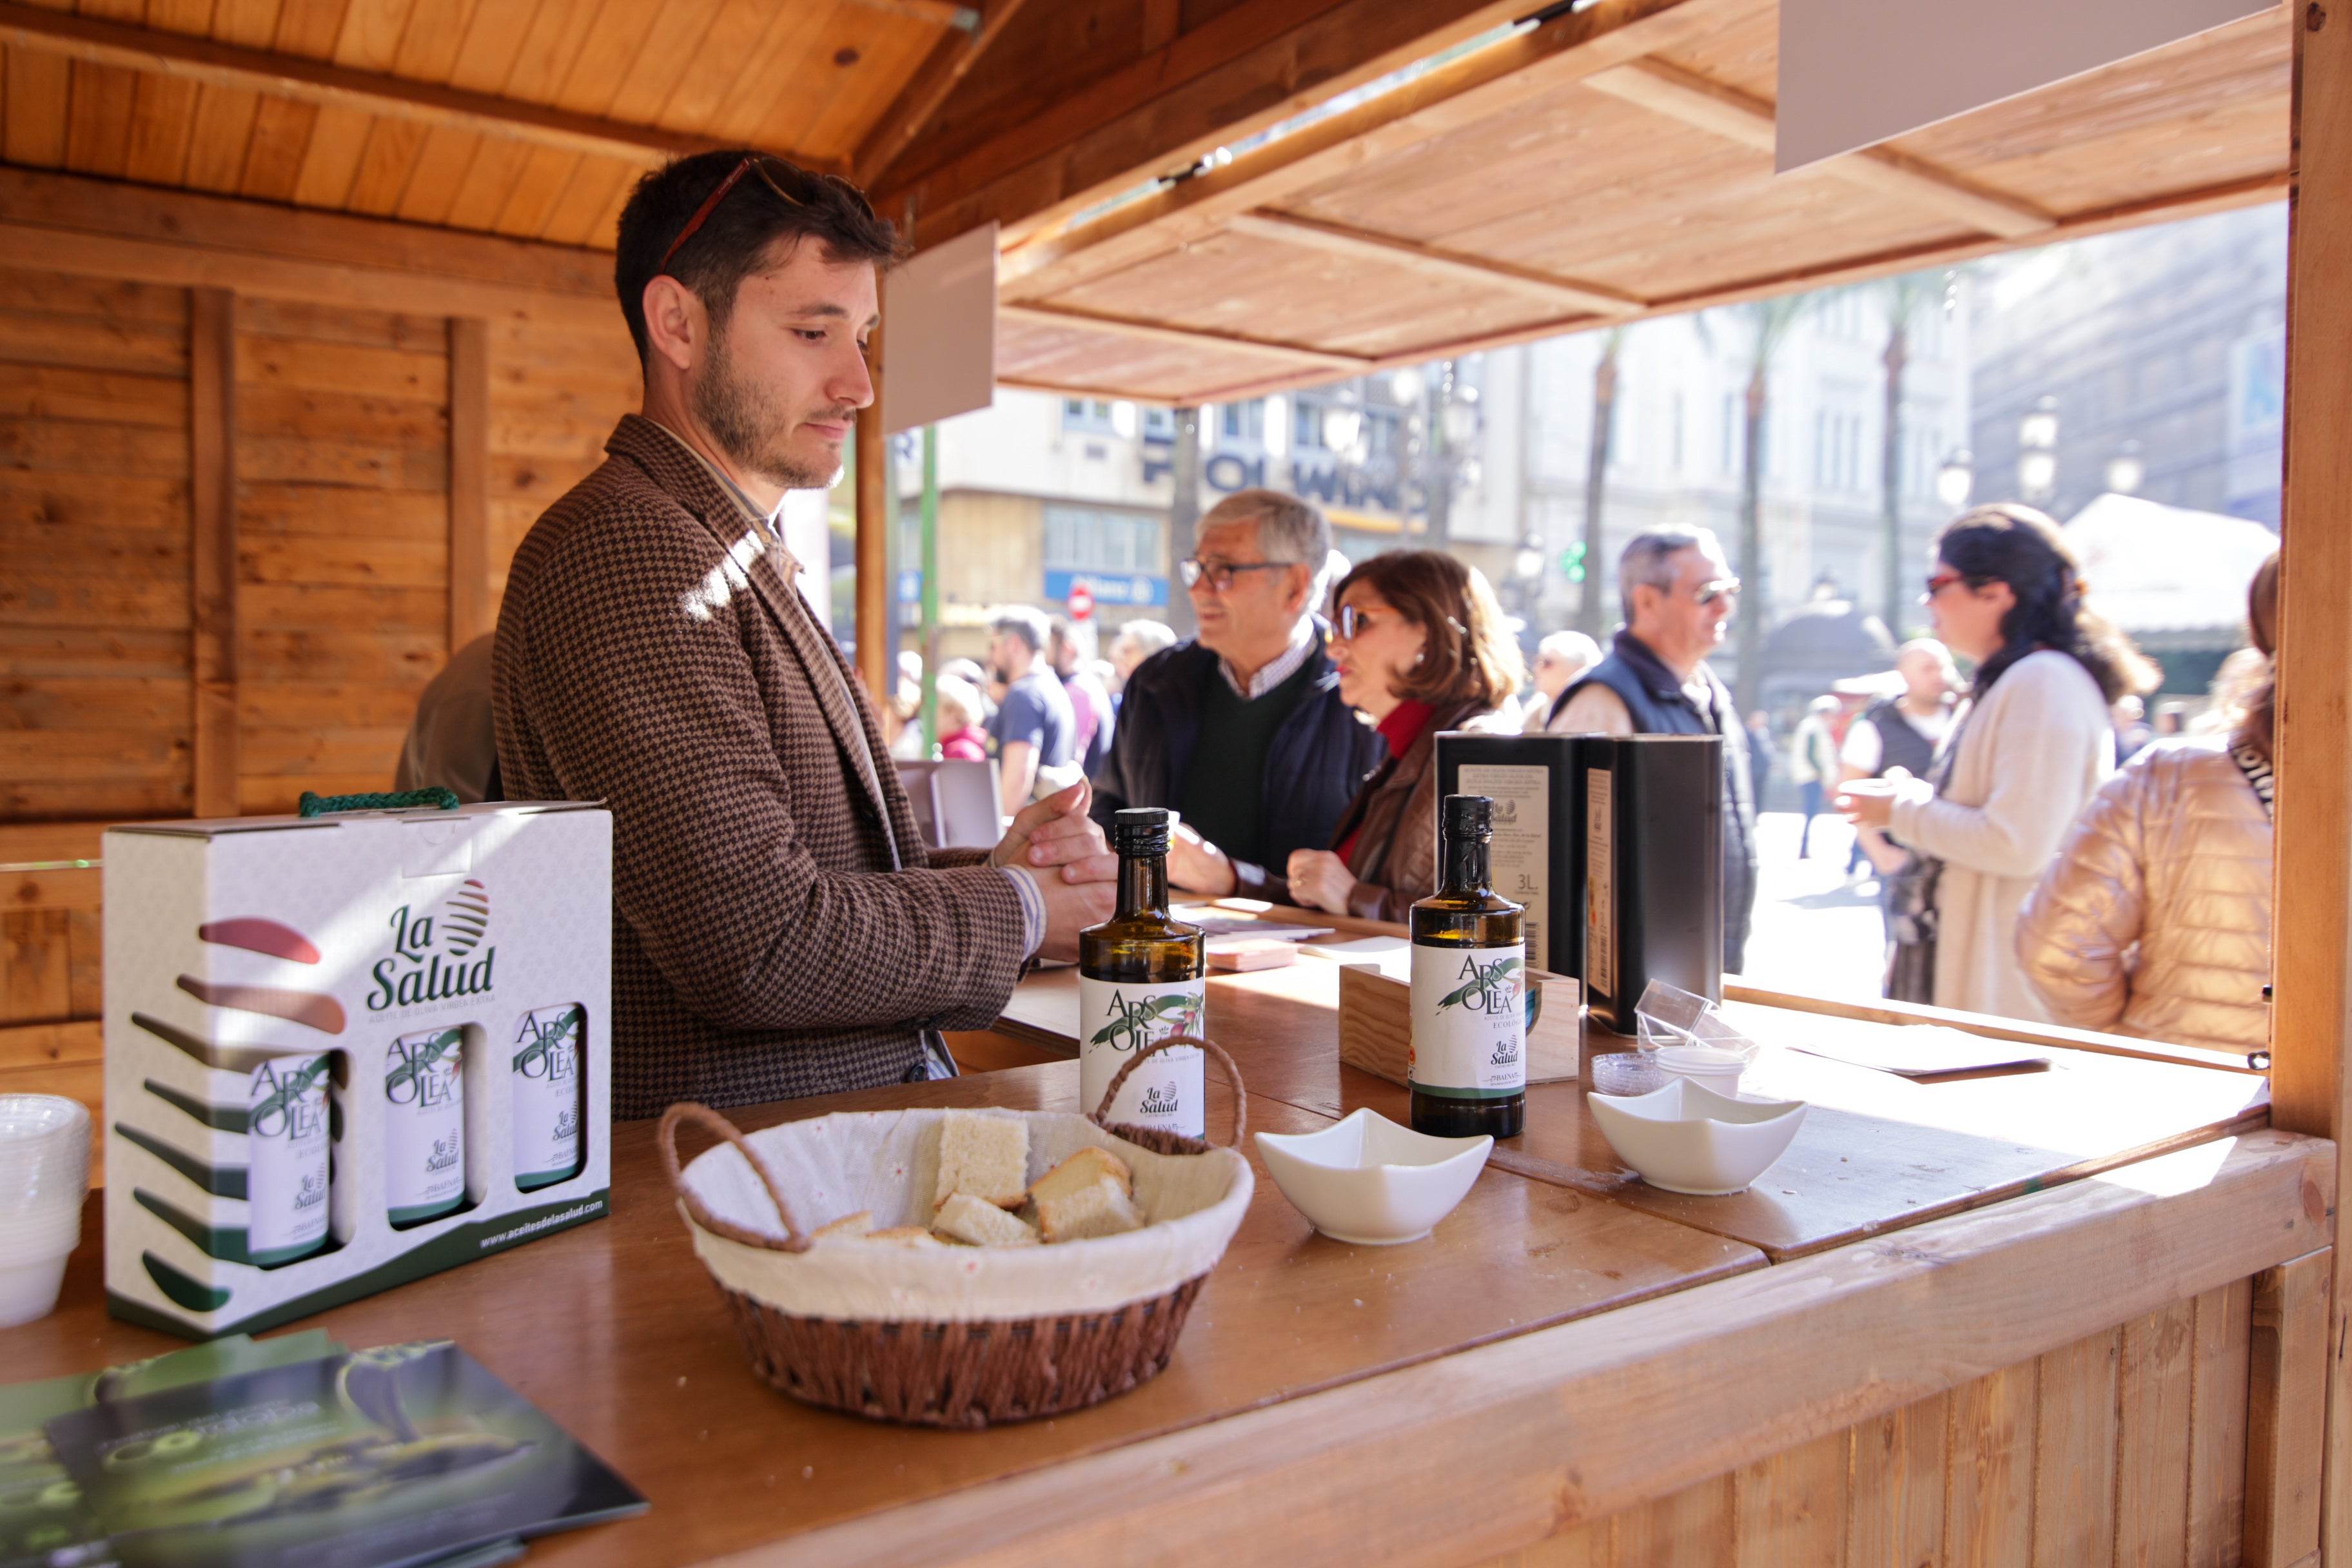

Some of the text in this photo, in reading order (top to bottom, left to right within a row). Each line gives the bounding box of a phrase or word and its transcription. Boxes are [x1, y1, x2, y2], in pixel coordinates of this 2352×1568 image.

[1493, 813, 1517, 822] alud
[390, 904, 435, 963] La
[368, 945, 496, 1011] Salud
[1455, 954, 1504, 990] ARS
[402, 1009, 412, 1018] DE
[415, 1004, 439, 1015] OLIVA
[1104, 988, 1157, 1030] ARS
[1461, 986, 1512, 1015] OLEA
[514, 1011, 567, 1051] ARS
[387, 1032, 441, 1074] ARS
[1491, 1050, 1518, 1065] Salud
[1496, 1041, 1507, 1055] La
[521, 1049, 574, 1082] OLEA
[251, 1059, 313, 1104] ARS
[386, 1072, 452, 1108] OLEA
[1146, 1086, 1161, 1102] La
[559, 1110, 569, 1126] La
[1139, 1099, 1179, 1113] Salud
[255, 1103, 321, 1141] OLEA
[553, 1119, 578, 1141] Salud
[427, 1148, 459, 1172] Salud
[434, 1139, 446, 1156] La
[302, 1173, 315, 1193] La
[295, 1185, 326, 1210] Salud
[480, 1200, 603, 1250] www.aceitesdelasalud.com
